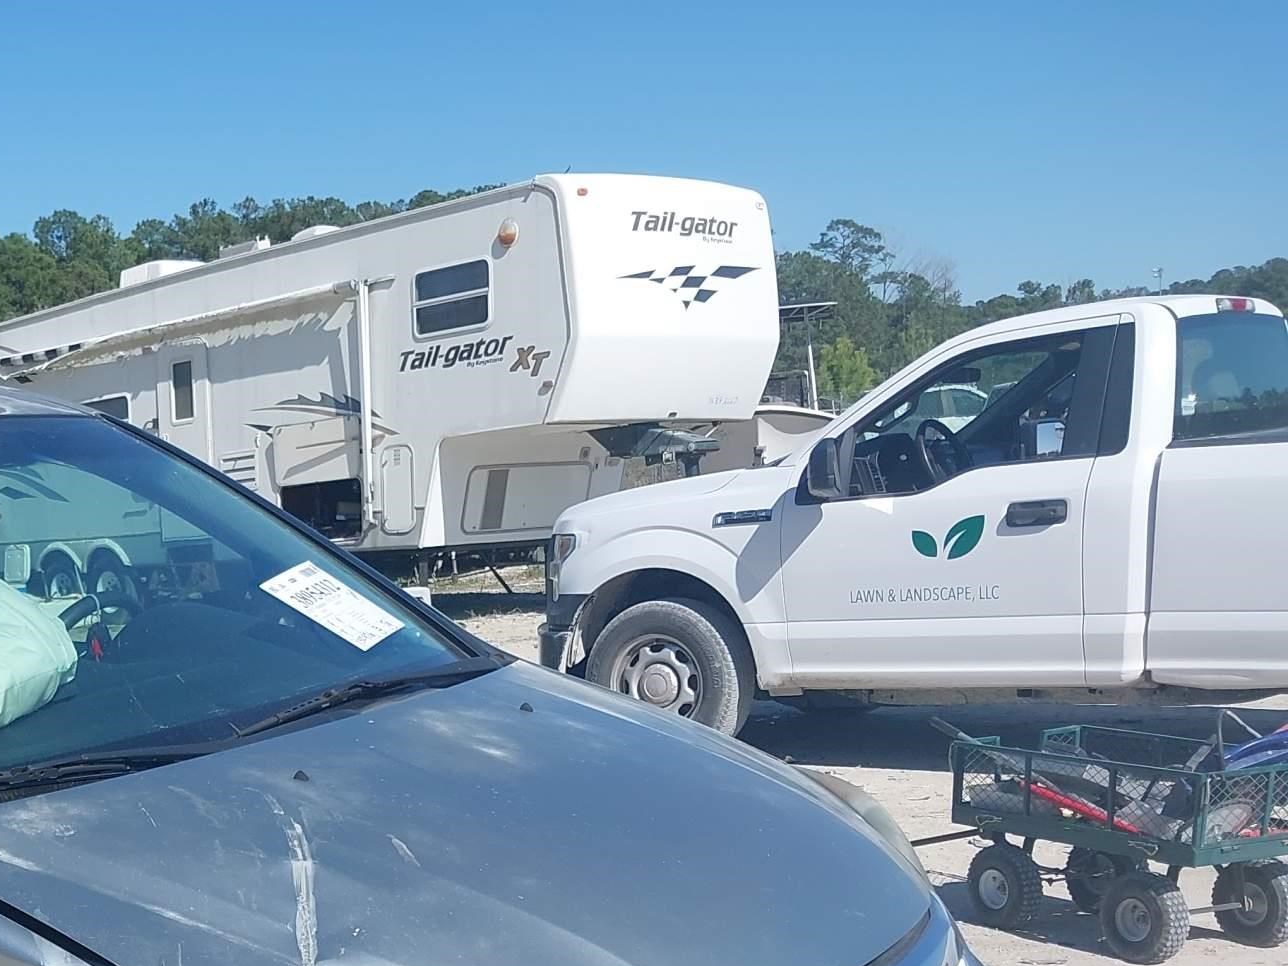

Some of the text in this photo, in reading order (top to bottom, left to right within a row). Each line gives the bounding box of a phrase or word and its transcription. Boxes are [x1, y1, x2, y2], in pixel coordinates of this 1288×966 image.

[631, 210, 738, 238] Tail-gator
[399, 335, 551, 377] Tail-gator XT
[850, 585, 1000, 604] LAWN & LANDSCAPE, LLC
